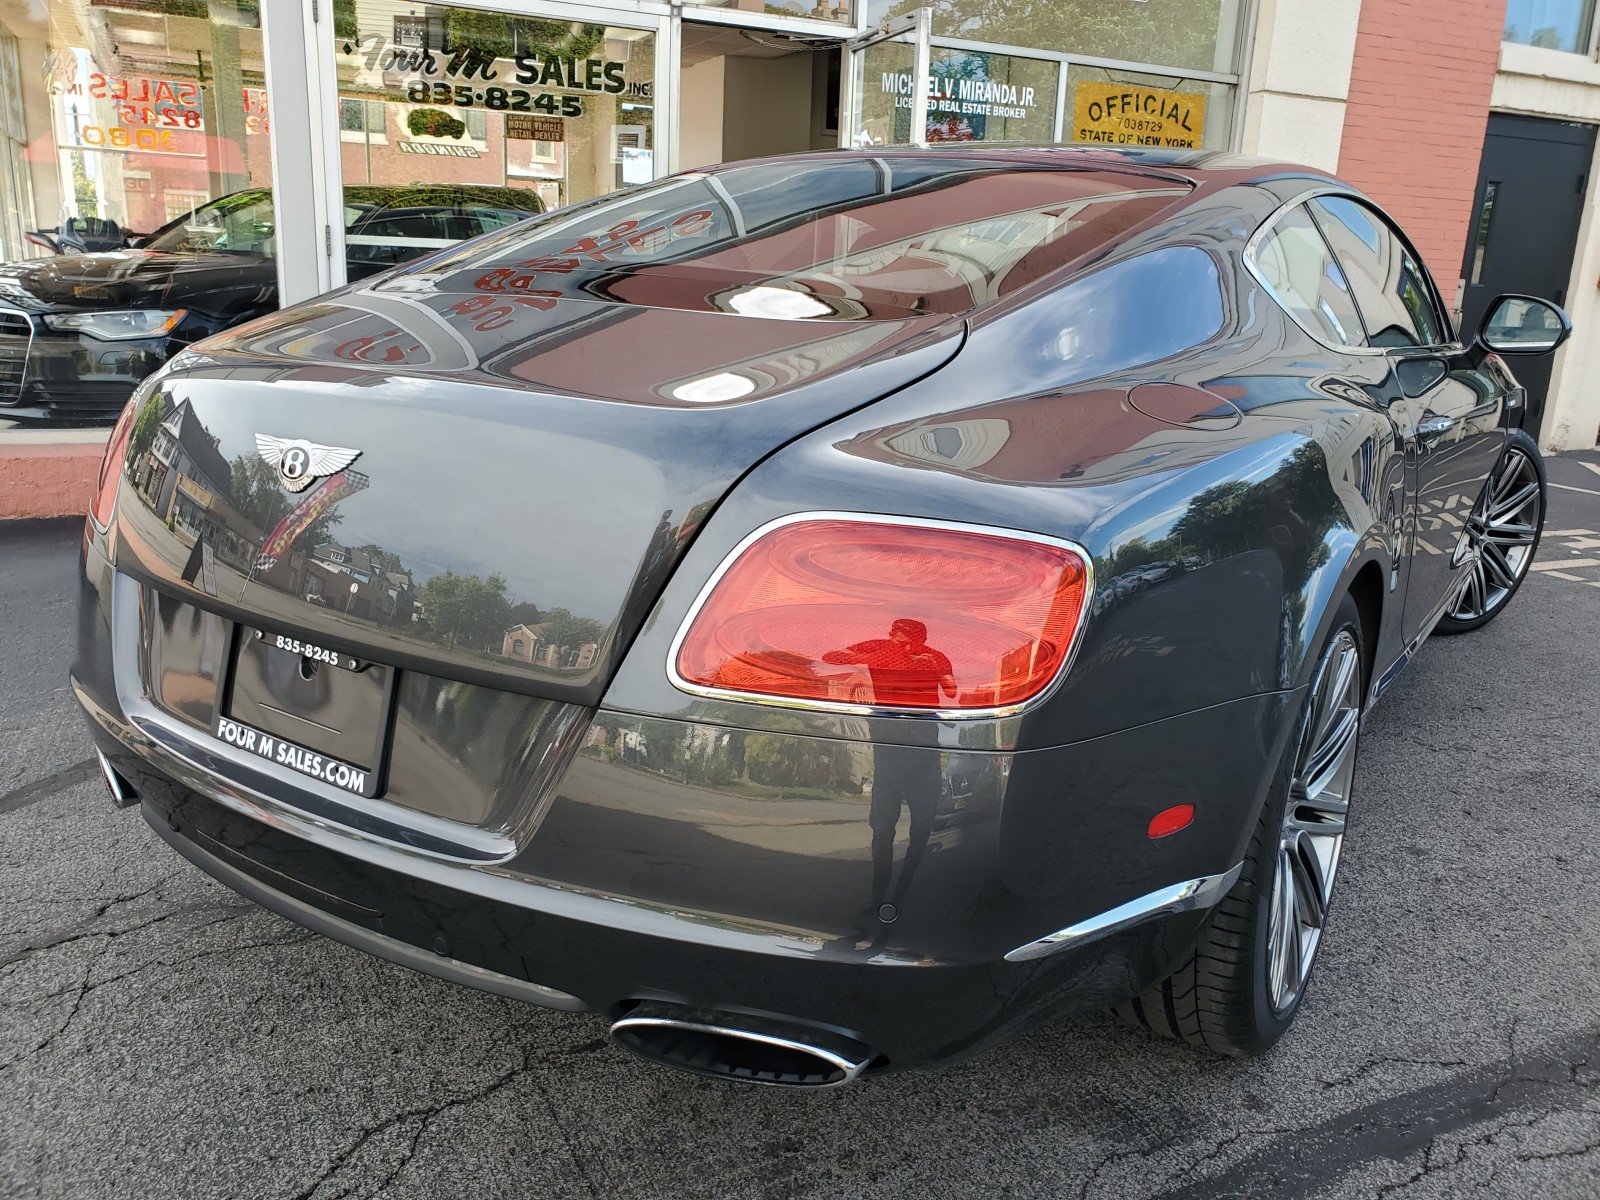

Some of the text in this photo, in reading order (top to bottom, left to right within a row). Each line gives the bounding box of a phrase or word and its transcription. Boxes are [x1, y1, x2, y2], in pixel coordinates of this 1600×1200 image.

[515, 55, 627, 94] SALES
[881, 72, 1038, 107] MICHEL V. MIRANDA JR.
[895, 96, 1027, 119] LICEED REAL ESTATE BROKER
[1088, 93, 1193, 132] OFFICIAL
[508, 121, 562, 132] MOTOR VEHICLE
[509, 129, 560, 140] RETAIL DEALER
[1080, 128, 1193, 149] STATE OF NEW YORK
[1117, 117, 1163, 133] 7038729
[276, 635, 339, 666] 835-8245
[217, 719, 366, 794] FOUR M SALES.COM
